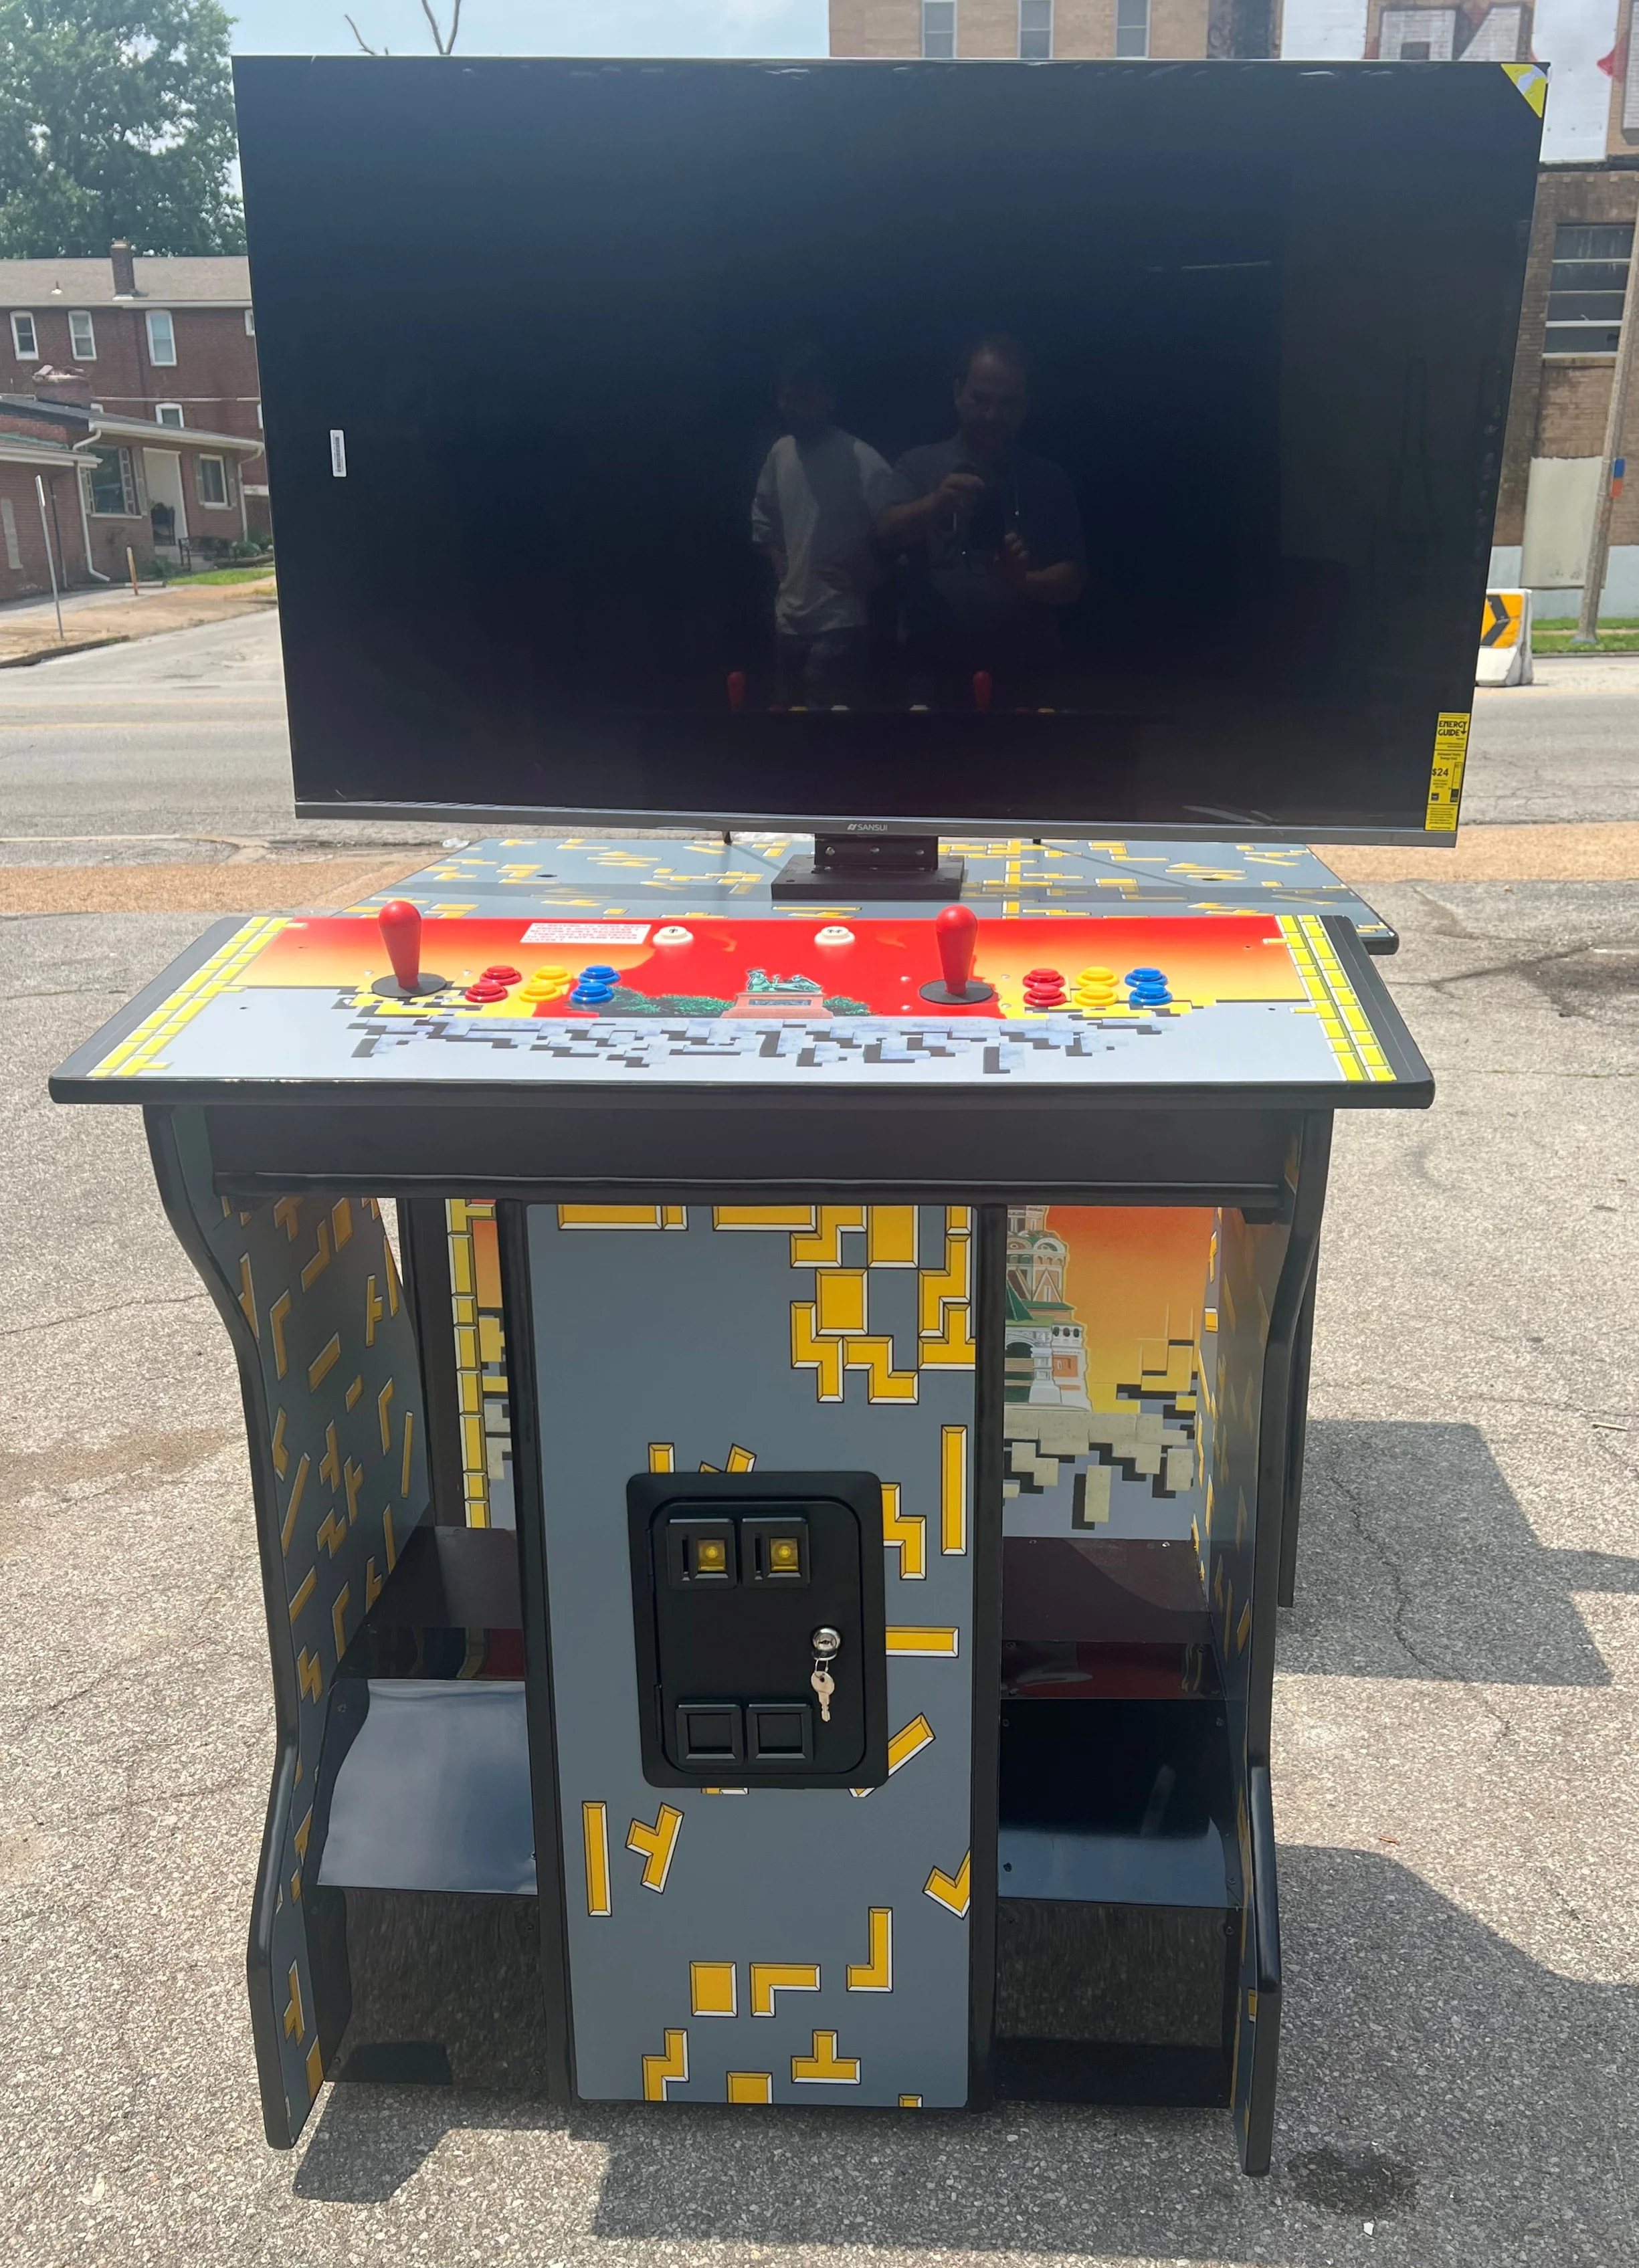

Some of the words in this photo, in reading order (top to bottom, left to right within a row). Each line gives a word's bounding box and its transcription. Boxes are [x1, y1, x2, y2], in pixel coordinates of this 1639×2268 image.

[1439, 720, 1467, 728] ENERGY
[1432, 768, 1448, 777] $24
[858, 823, 888, 831] SANSUI
